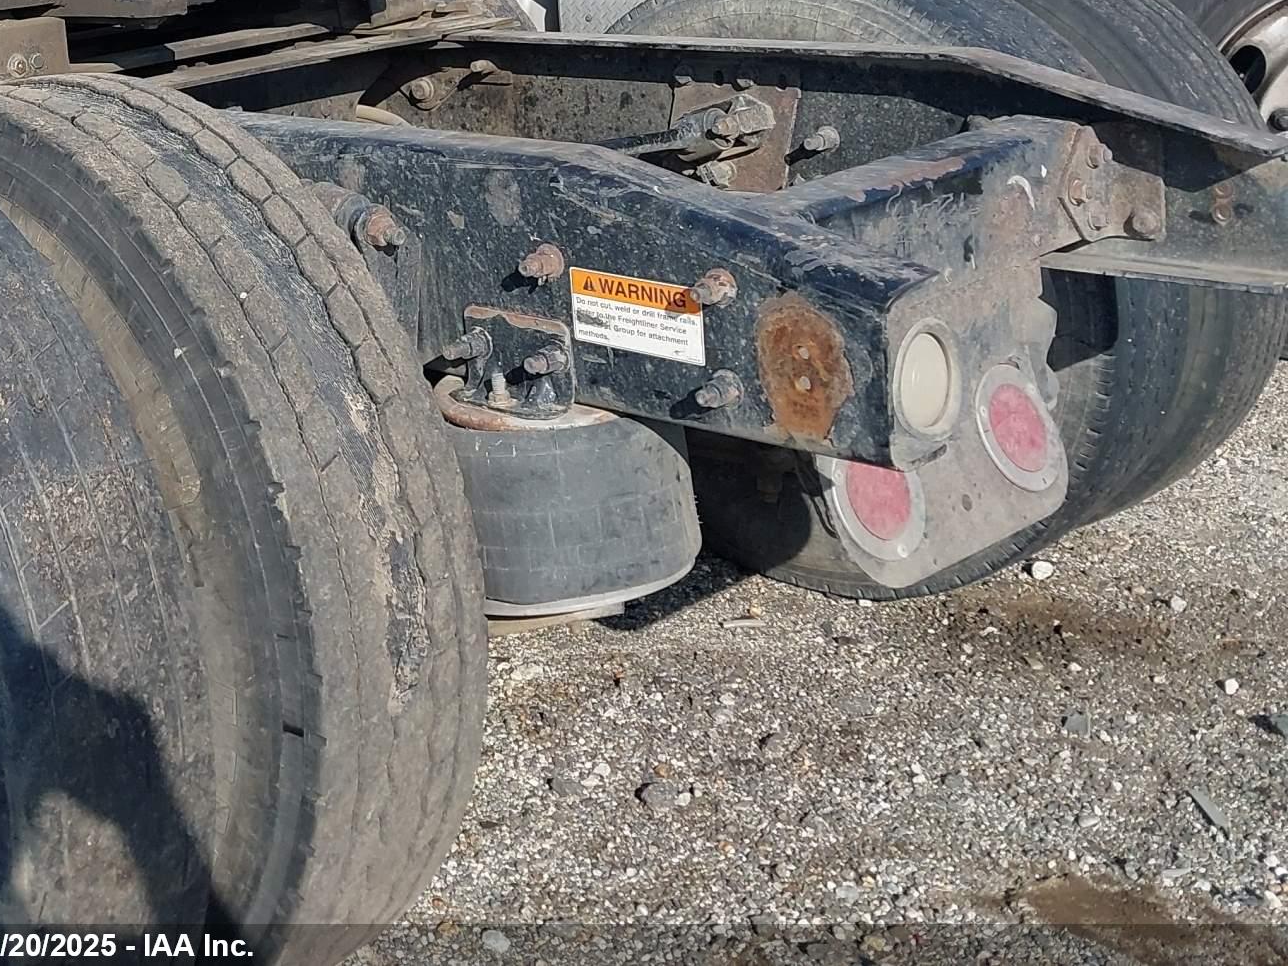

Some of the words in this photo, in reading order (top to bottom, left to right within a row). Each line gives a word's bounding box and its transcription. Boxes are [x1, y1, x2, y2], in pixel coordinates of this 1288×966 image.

[599, 277, 687, 308] WARNING
[576, 296, 586, 306] Do
[587, 298, 599, 308] not
[615, 304, 631, 314] weld
[632, 307, 641, 315] or
[641, 309, 656, 318] drill
[657, 310, 678, 322] frame
[578, 328, 610, 341] methods.
[613, 324, 635, 337] Group
[636, 328, 647, 338] for
[648, 329, 688, 346] attachment
[617, 313, 658, 330] Freightliner
[659, 322, 687, 335] Service
